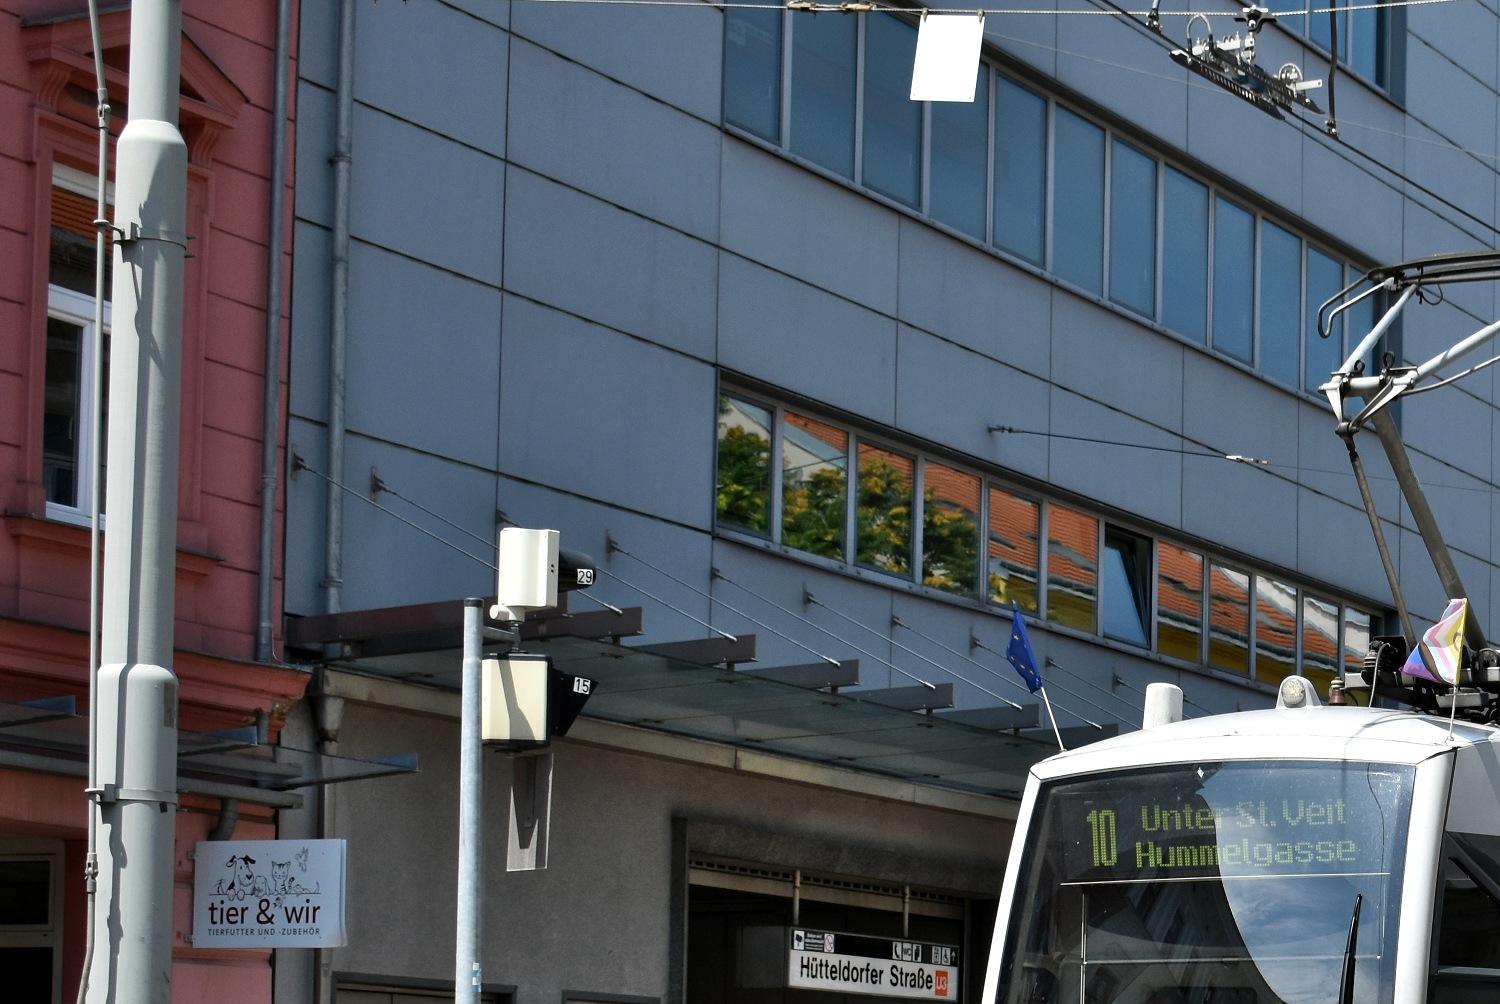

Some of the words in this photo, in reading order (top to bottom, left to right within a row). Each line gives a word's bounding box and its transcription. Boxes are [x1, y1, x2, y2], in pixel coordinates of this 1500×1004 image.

[578, 570, 593, 584] 29
[575, 679, 590, 694] 15
[1142, 803, 1230, 832] Unter
[1282, 798, 1346, 828] Veit
[1087, 810, 1118, 867] 10
[1136, 838, 1357, 868] Hummelgasse
[208, 900, 249, 924] tier
[256, 899, 274, 925] &
[284, 899, 321, 923] wir
[208, 928, 255, 936] TIERFUTTER
[800, 956, 884, 985] Hütteldorfer
[889, 965, 933, 990] Straße
[936, 975, 947, 991] U3
